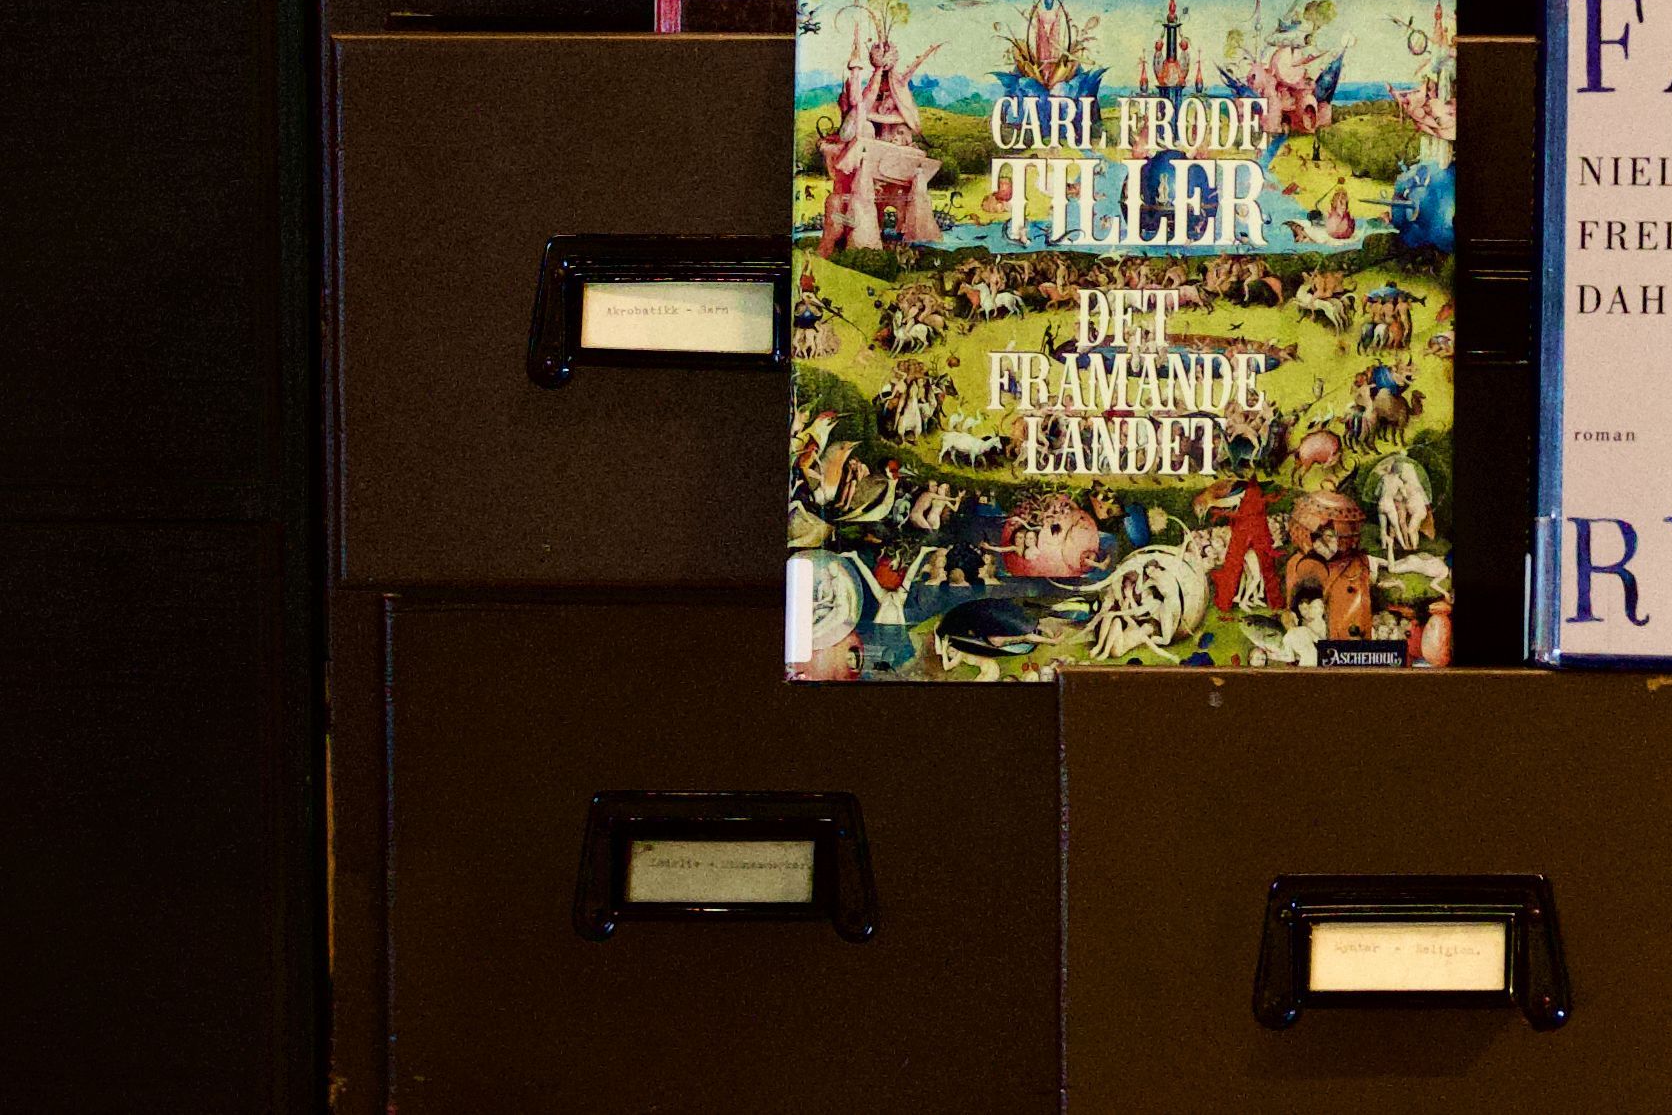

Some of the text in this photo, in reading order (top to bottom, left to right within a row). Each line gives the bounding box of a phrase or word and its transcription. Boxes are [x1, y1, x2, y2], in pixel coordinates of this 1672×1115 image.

[990, 96, 1269, 151] CARL FRODE
[990, 157, 1267, 247] TILLER
[1076, 288, 1179, 348] DET
[987, 352, 1266, 411] FRAMANDE
[1023, 416, 1228, 476] LANDET
[1574, 429, 1638, 442] roman
